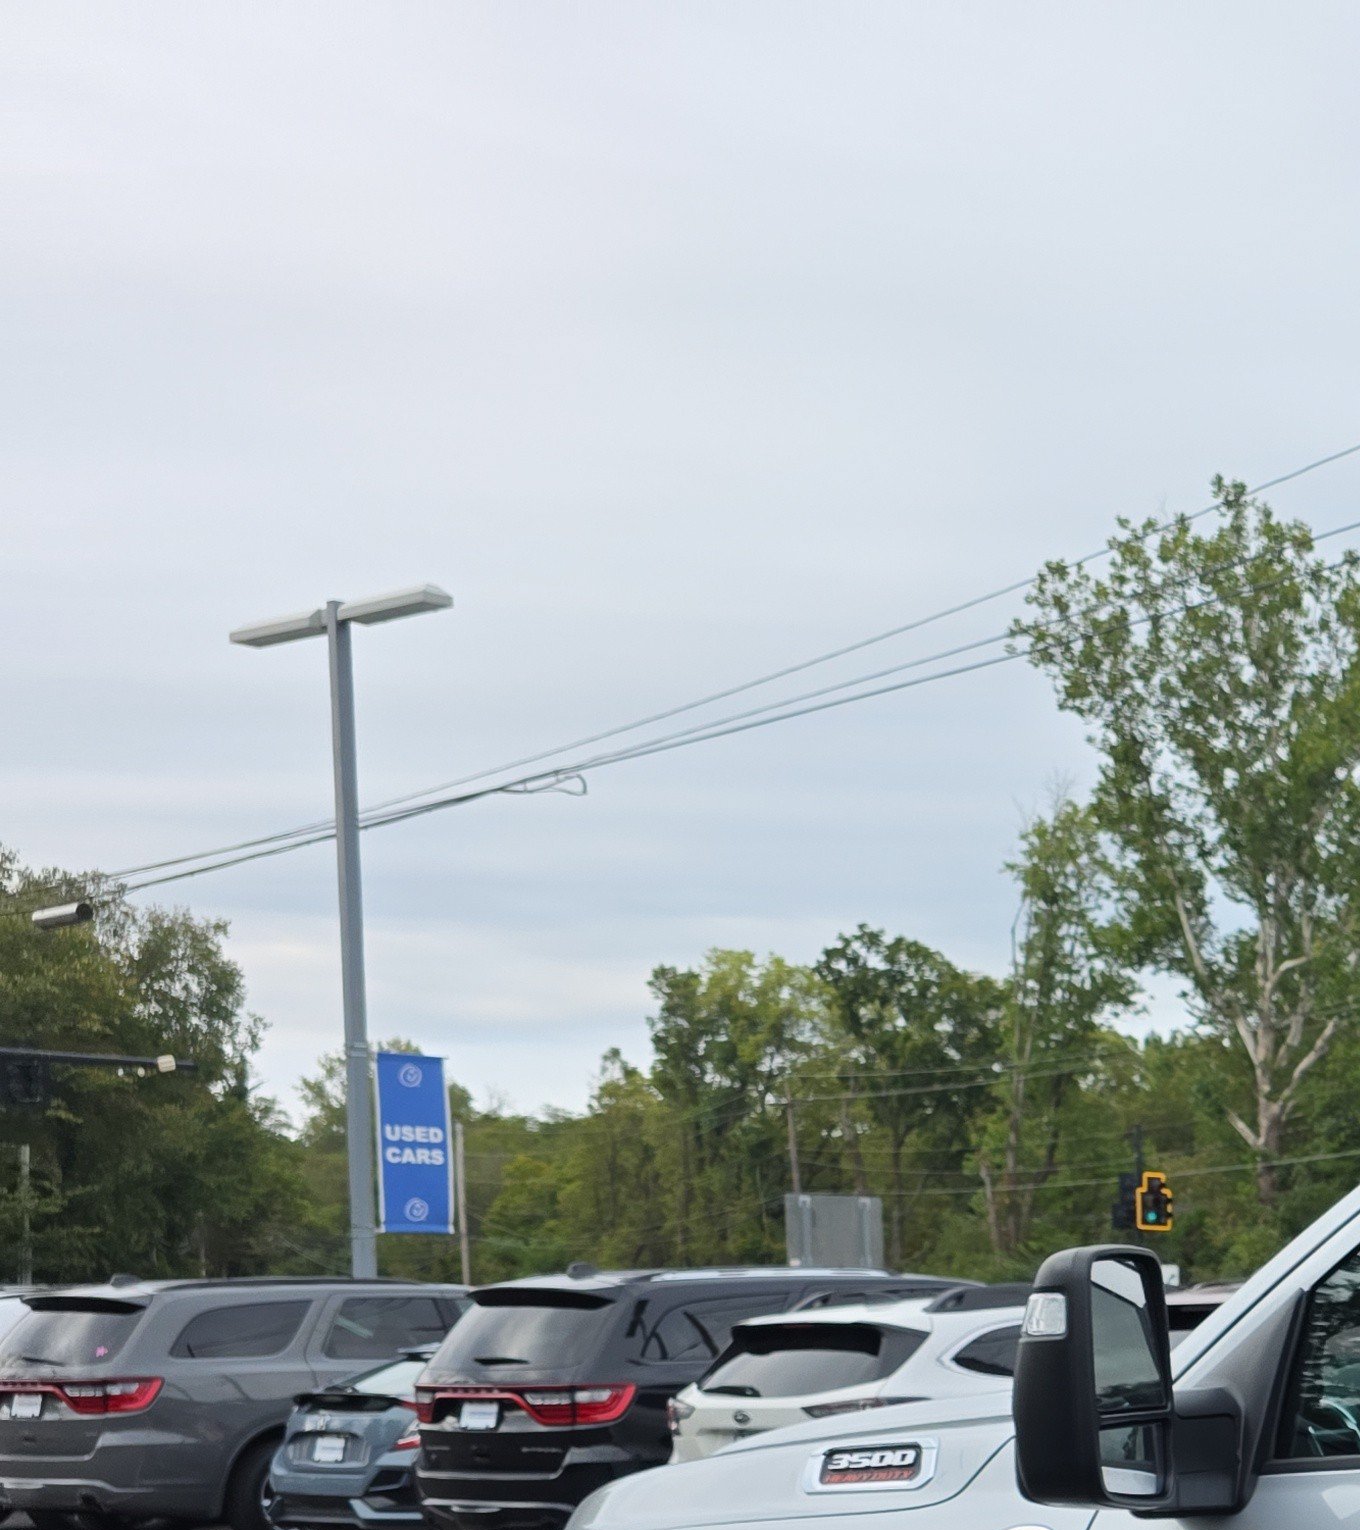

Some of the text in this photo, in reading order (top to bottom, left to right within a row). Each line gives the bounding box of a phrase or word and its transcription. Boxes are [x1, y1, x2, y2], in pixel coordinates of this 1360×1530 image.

[385, 1124, 443, 1143] USED
[386, 1147, 444, 1165] CARS
[827, 1450, 917, 1470] 3500
